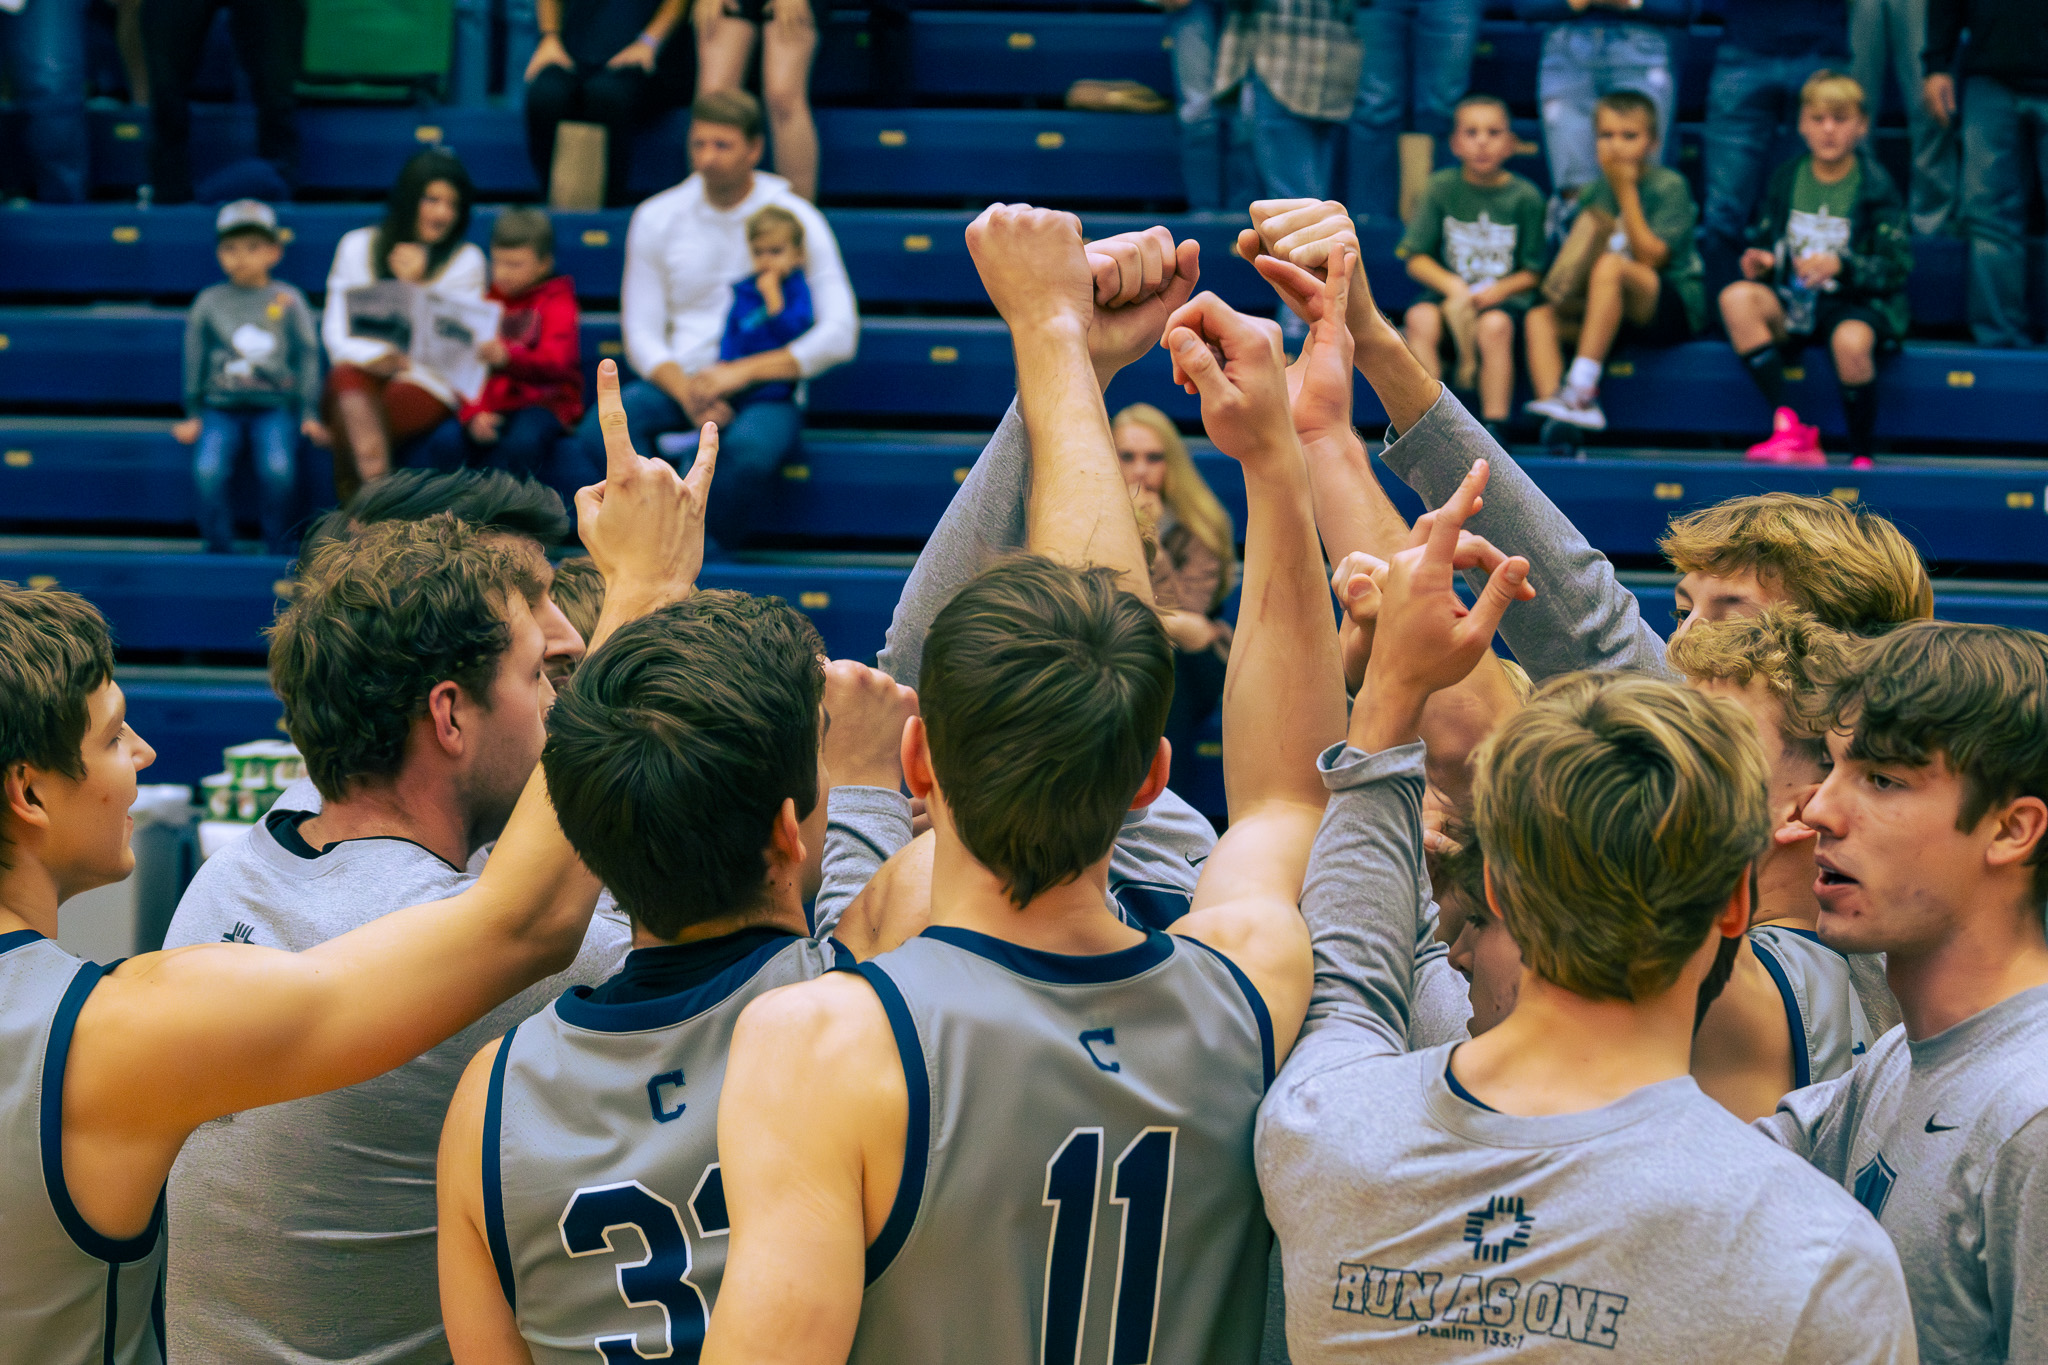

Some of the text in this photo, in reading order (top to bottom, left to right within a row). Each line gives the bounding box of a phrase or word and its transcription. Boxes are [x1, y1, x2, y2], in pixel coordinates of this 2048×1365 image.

[1078, 1027, 1120, 1073] C
[646, 1068, 686, 1124] C
[1040, 1126, 1178, 1365] 11
[1333, 1262, 1628, 1349] RUN AS ONE
[1417, 1323, 1525, 1349] Psalm 133:1
